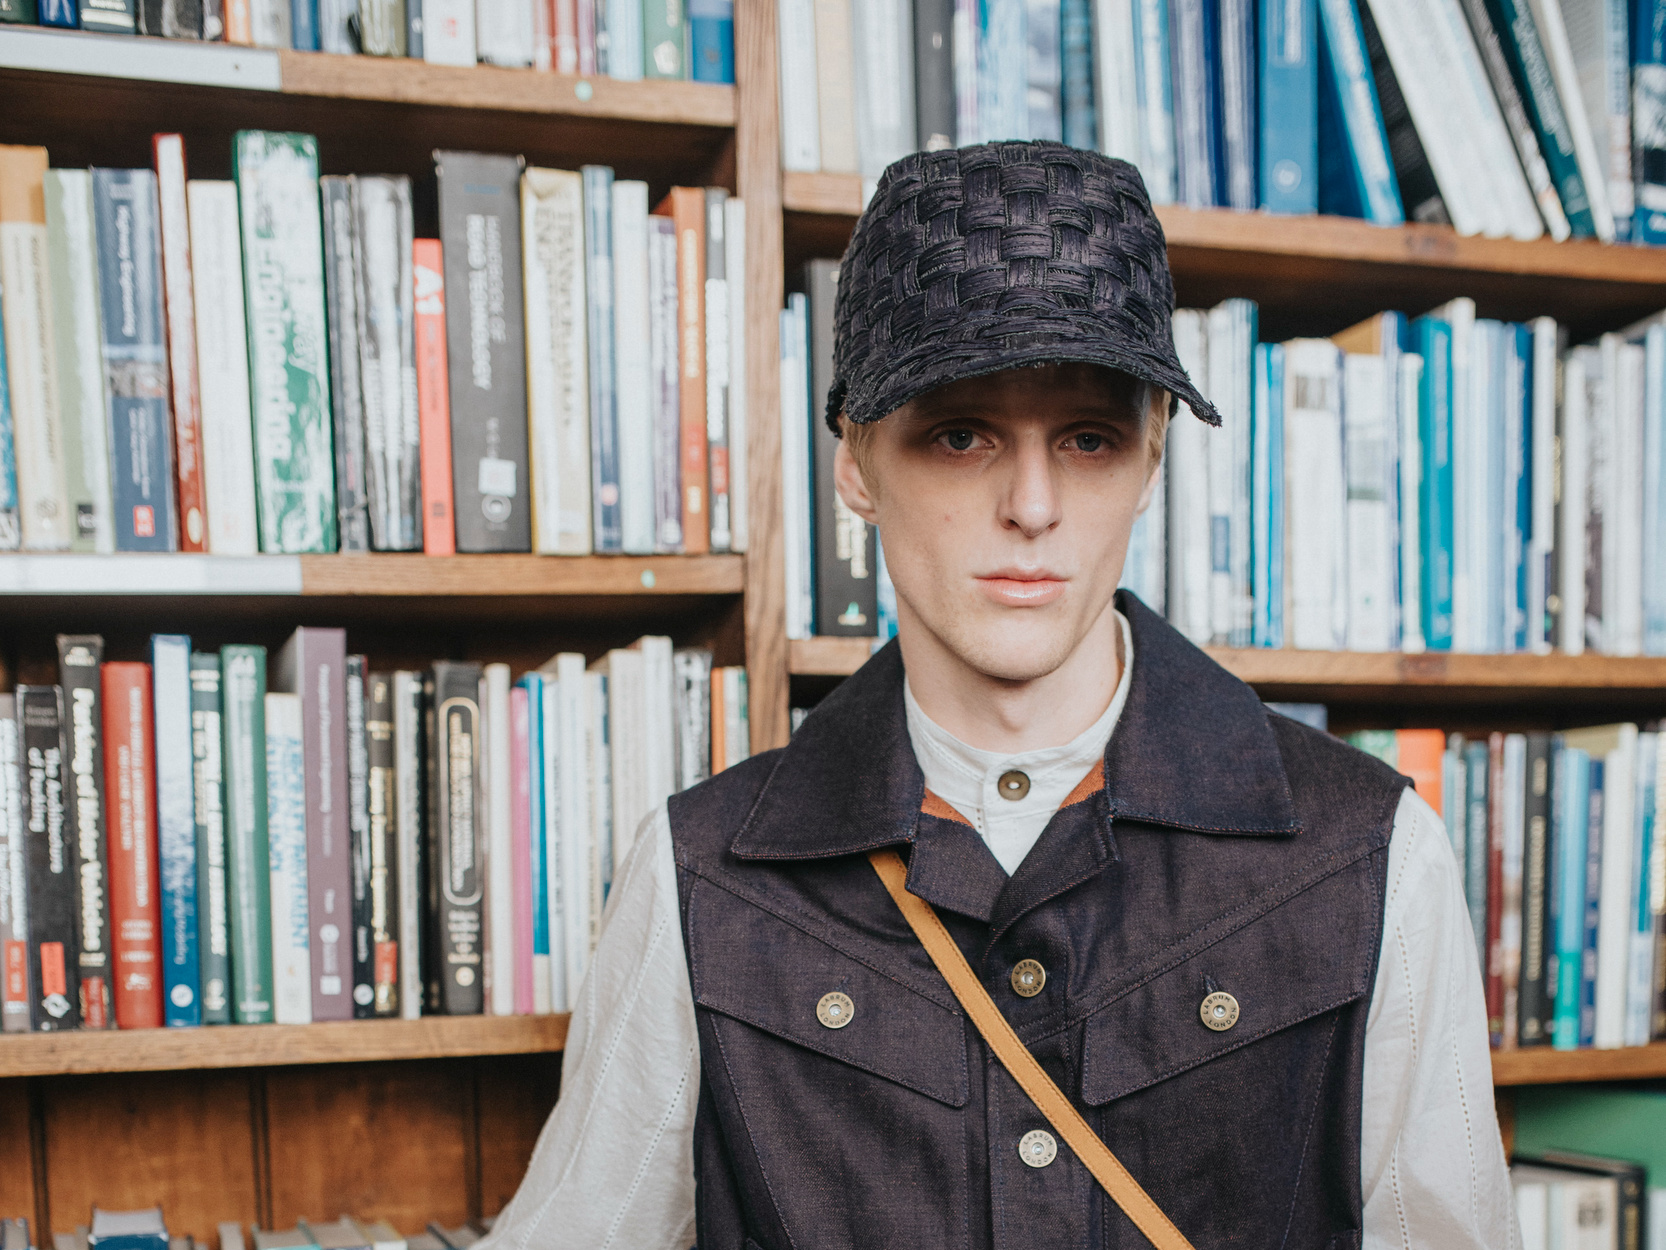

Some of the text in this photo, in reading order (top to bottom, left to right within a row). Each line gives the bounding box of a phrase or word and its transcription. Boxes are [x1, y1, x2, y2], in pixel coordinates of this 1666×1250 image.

[119, 260, 137, 337] Engineering
[415, 265, 443, 315] A1
[72, 689, 96, 776] Parking
[29, 749, 46, 834] of Parking
[76, 776, 98, 799] of
[45, 750, 64, 876] The Architecture
[77, 799, 100, 862] Motor
[81, 863, 103, 952] Vehicles
[1014, 961, 1042, 975] LABRUM
[1014, 980, 1042, 994] LONDON
[820, 994, 851, 1008] LABRUM
[1203, 995, 1231, 1015] LABRUM
[820, 1012, 851, 1026] LONDON
[1208, 1007, 1237, 1028] LONDON
[1023, 1132, 1053, 1146] LABRUM
[1022, 1152, 1053, 1165] LONDON
